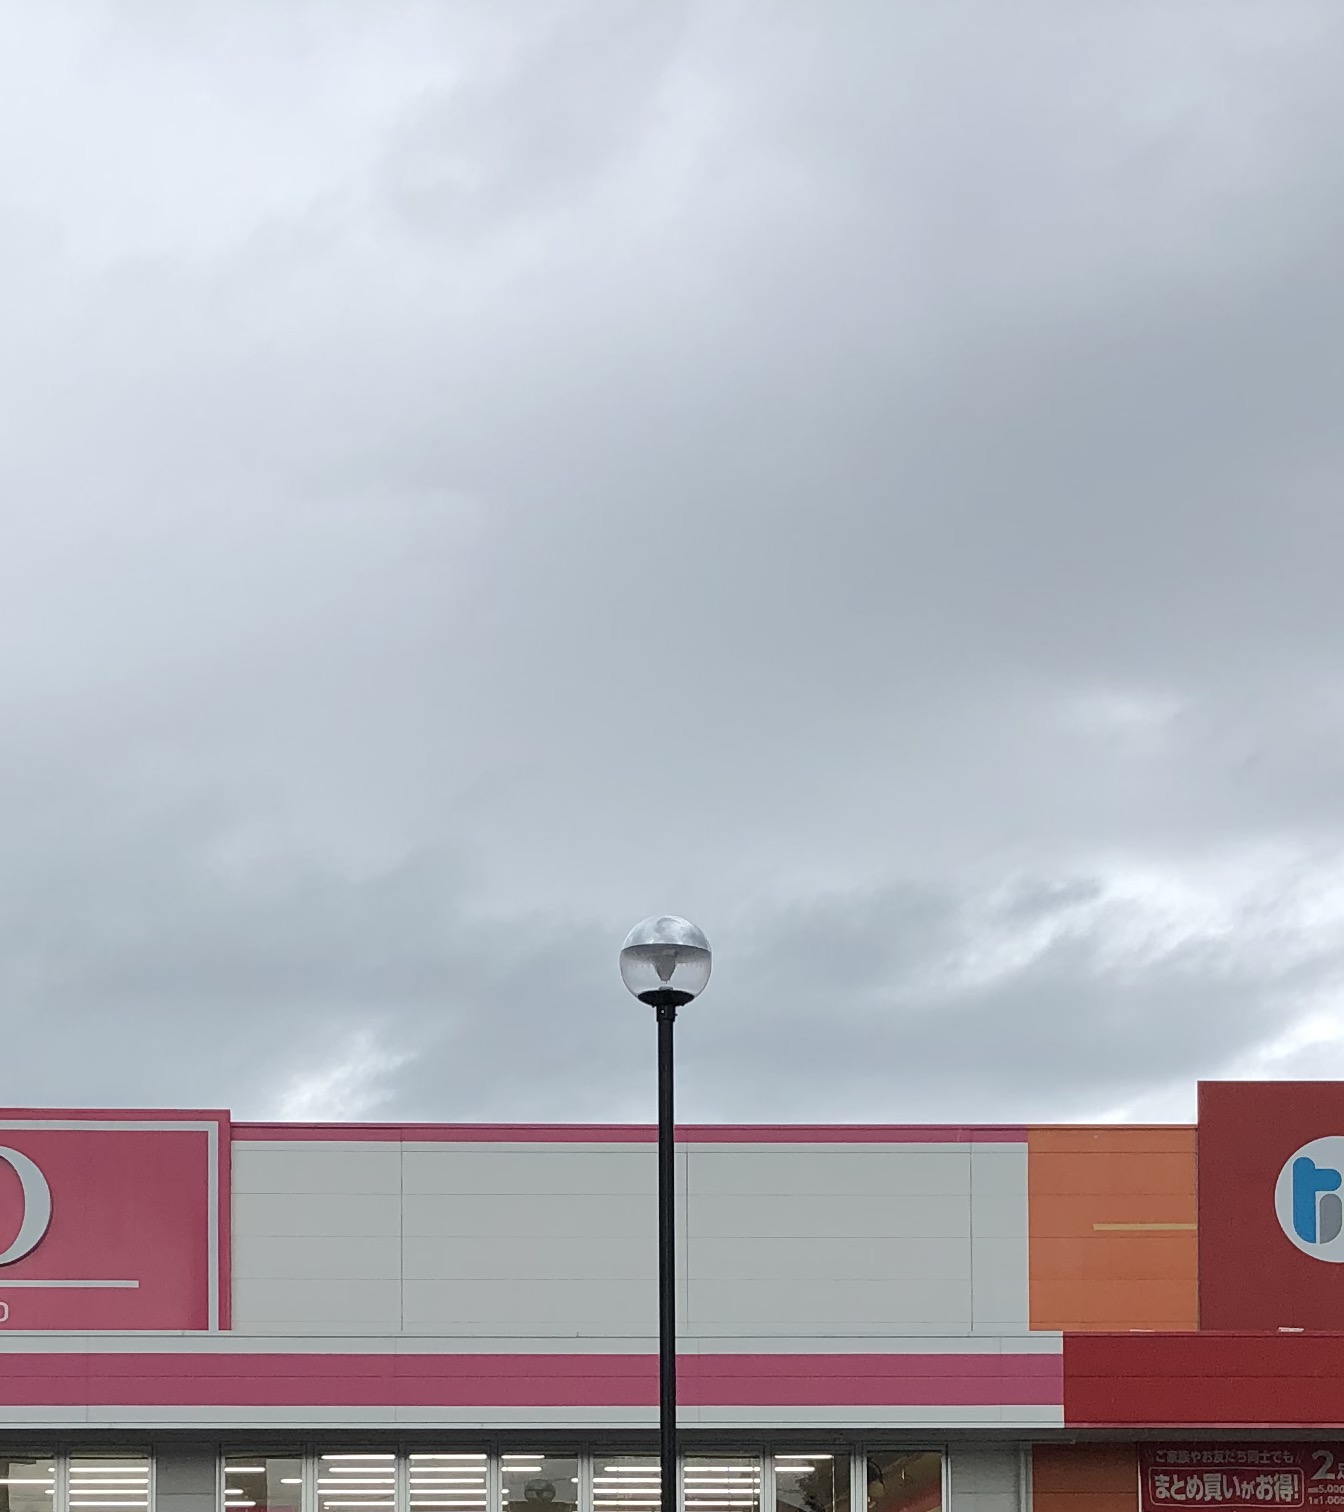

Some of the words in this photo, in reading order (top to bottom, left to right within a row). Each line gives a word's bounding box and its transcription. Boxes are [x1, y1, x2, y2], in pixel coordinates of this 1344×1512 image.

[1154, 1473, 1299, 1502] まとめ買いがお得!
